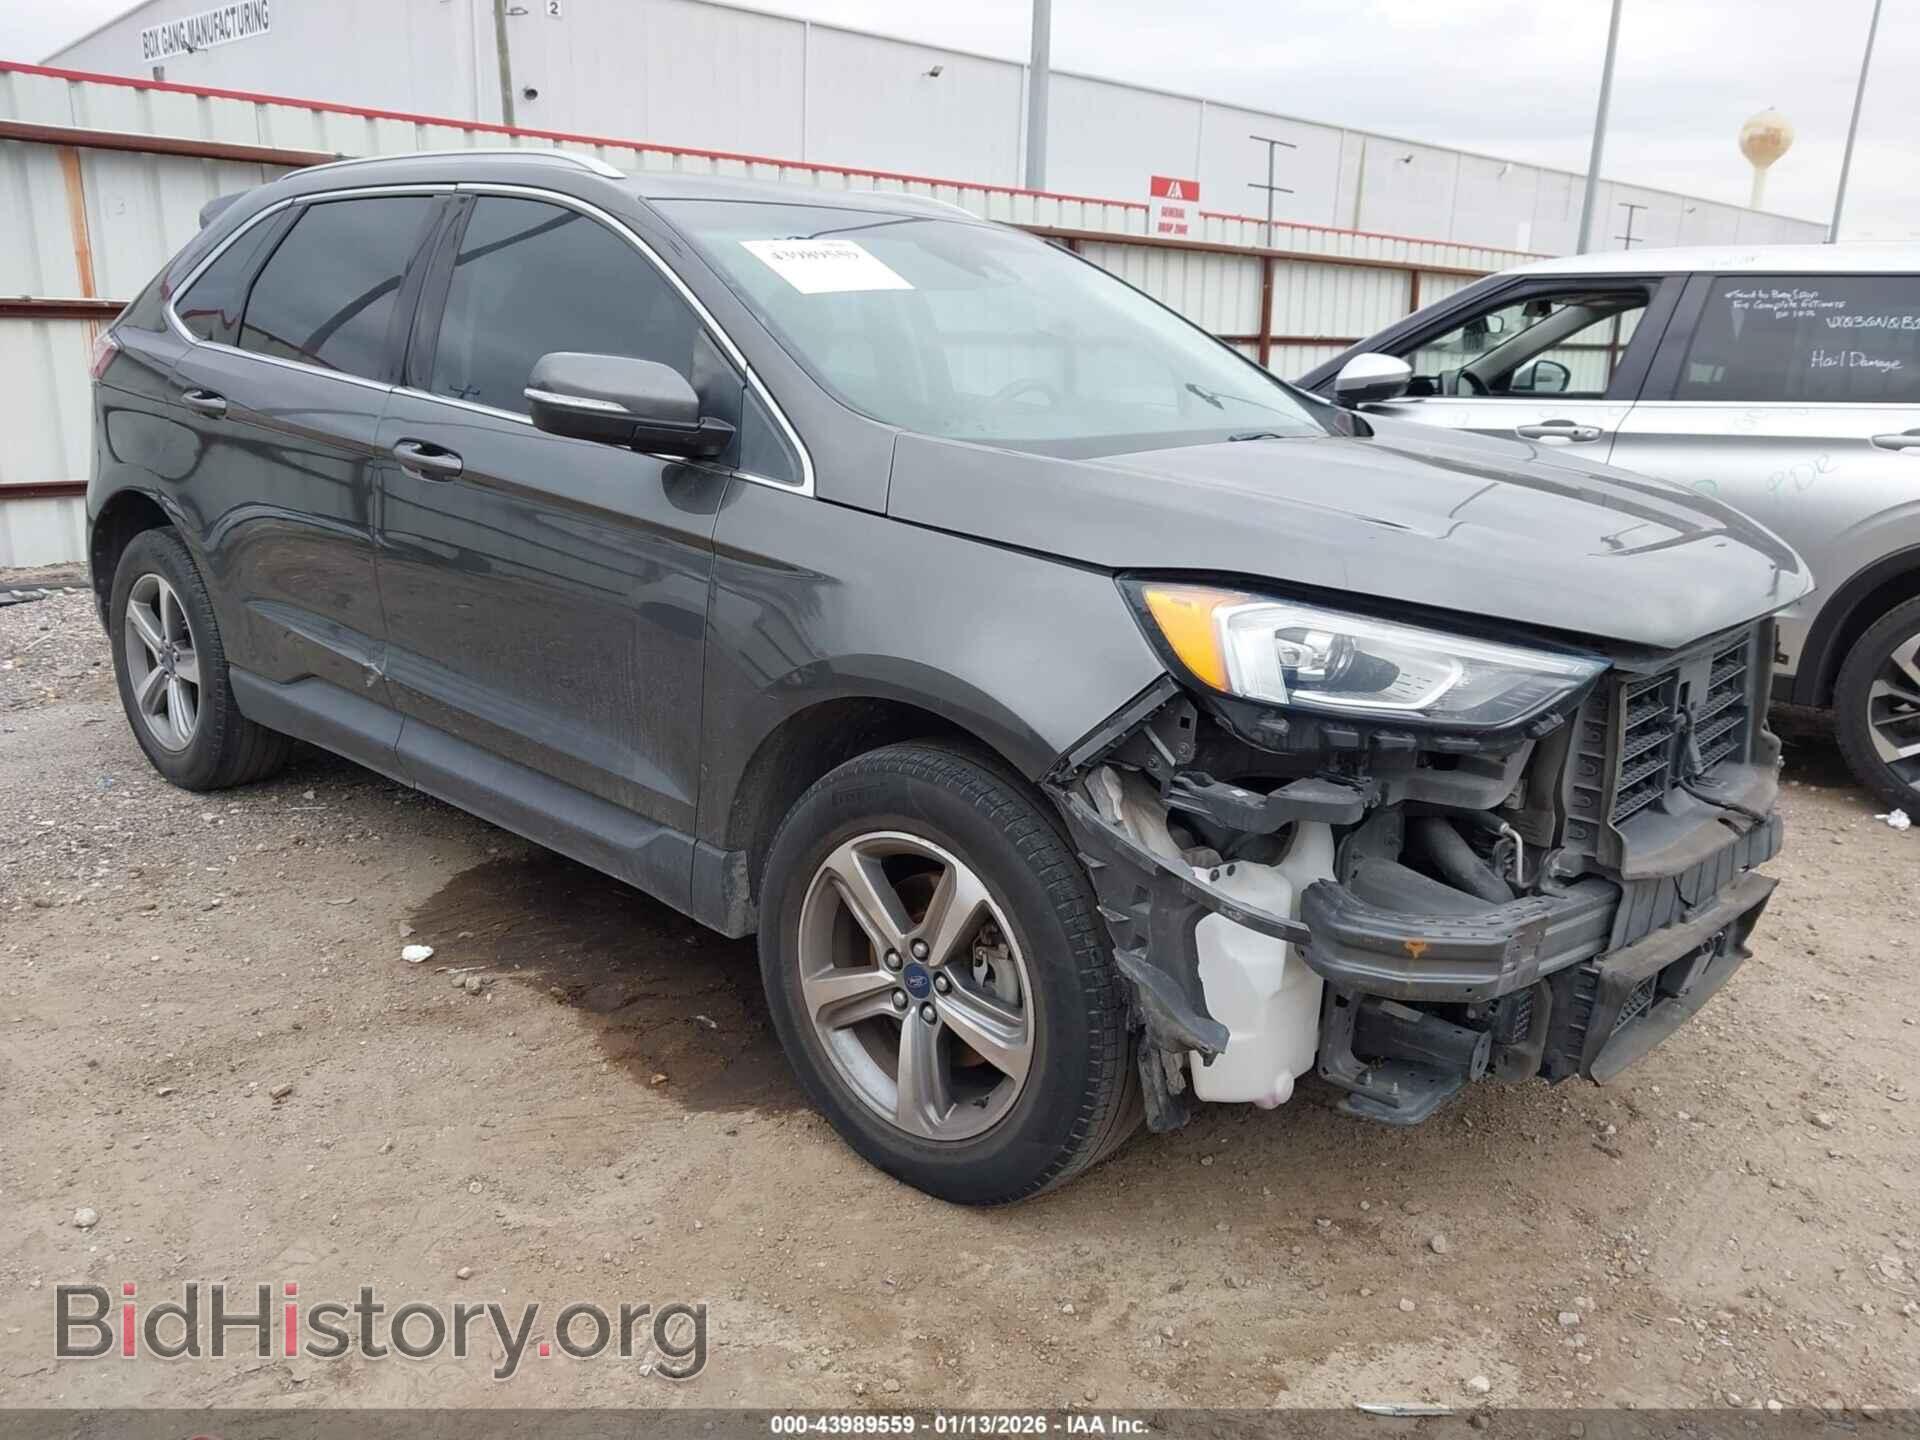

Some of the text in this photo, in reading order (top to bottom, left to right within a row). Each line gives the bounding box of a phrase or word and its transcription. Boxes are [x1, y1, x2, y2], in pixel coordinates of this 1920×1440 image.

[549, 1, 558, 15] 2
[142, 0, 269, 59] BOX GANG MANUFACTURING
[1811, 350, 1904, 373] Hail Damage
